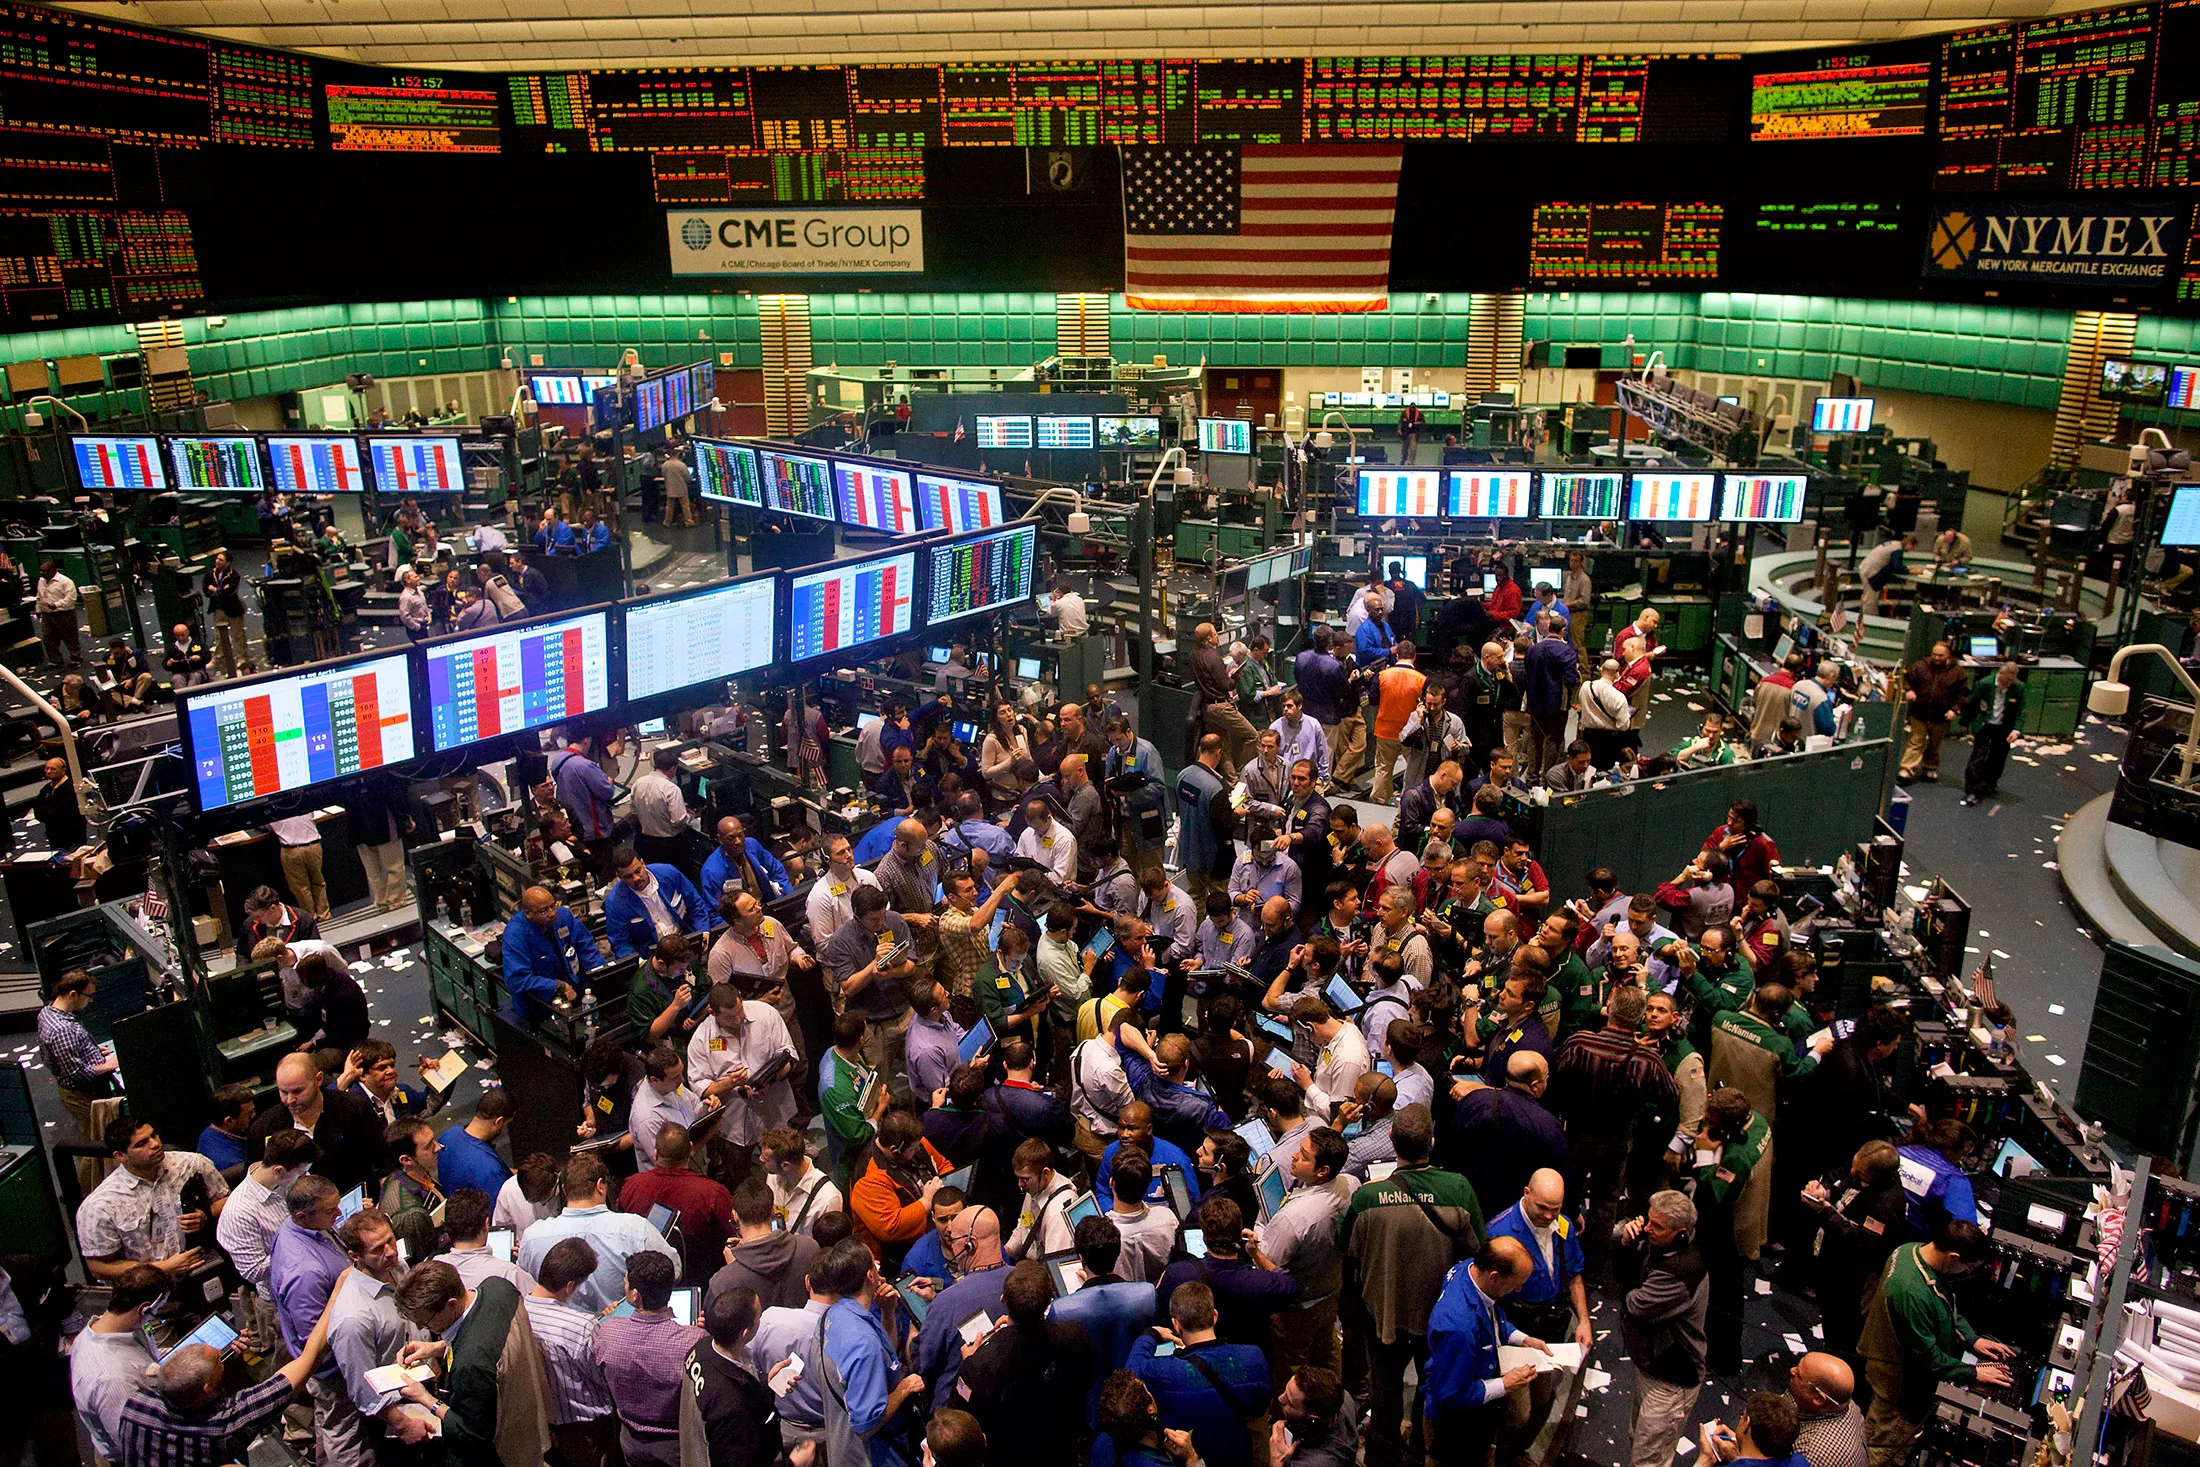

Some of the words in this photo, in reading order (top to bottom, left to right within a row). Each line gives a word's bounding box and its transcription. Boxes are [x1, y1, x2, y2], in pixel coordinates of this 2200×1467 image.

[1816, 56, 1870, 69] 1:52:57
[392, 76, 444, 88] 1:52:57
[718, 219, 797, 247] CME
[804, 219, 910, 253] Group
[1980, 217, 2175, 256] NYMEX
[728, 260, 781, 269] CME/Chicago
[783, 260, 805, 268] Board
[817, 259, 871, 268] Trade/NYMEX
[872, 260, 911, 268] Company
[1977, 259, 2000, 270] NEW
[2002, 260, 2029, 272] YORK
[2031, 261, 2098, 274] MERCANTILE
[2102, 263, 2165, 276] EXCHANGE
[546, 686, 564, 694] 10071
[546, 695, 565, 703] 10070
[223, 712, 245, 722] 3920
[225, 732, 247, 742] 3910
[338, 736, 358, 745] 3940
[227, 742, 248, 752] 3905
[228, 752, 250, 762] 3900
[340, 755, 359, 764] 3930
[1721, 1020, 1762, 1044] McNamara
